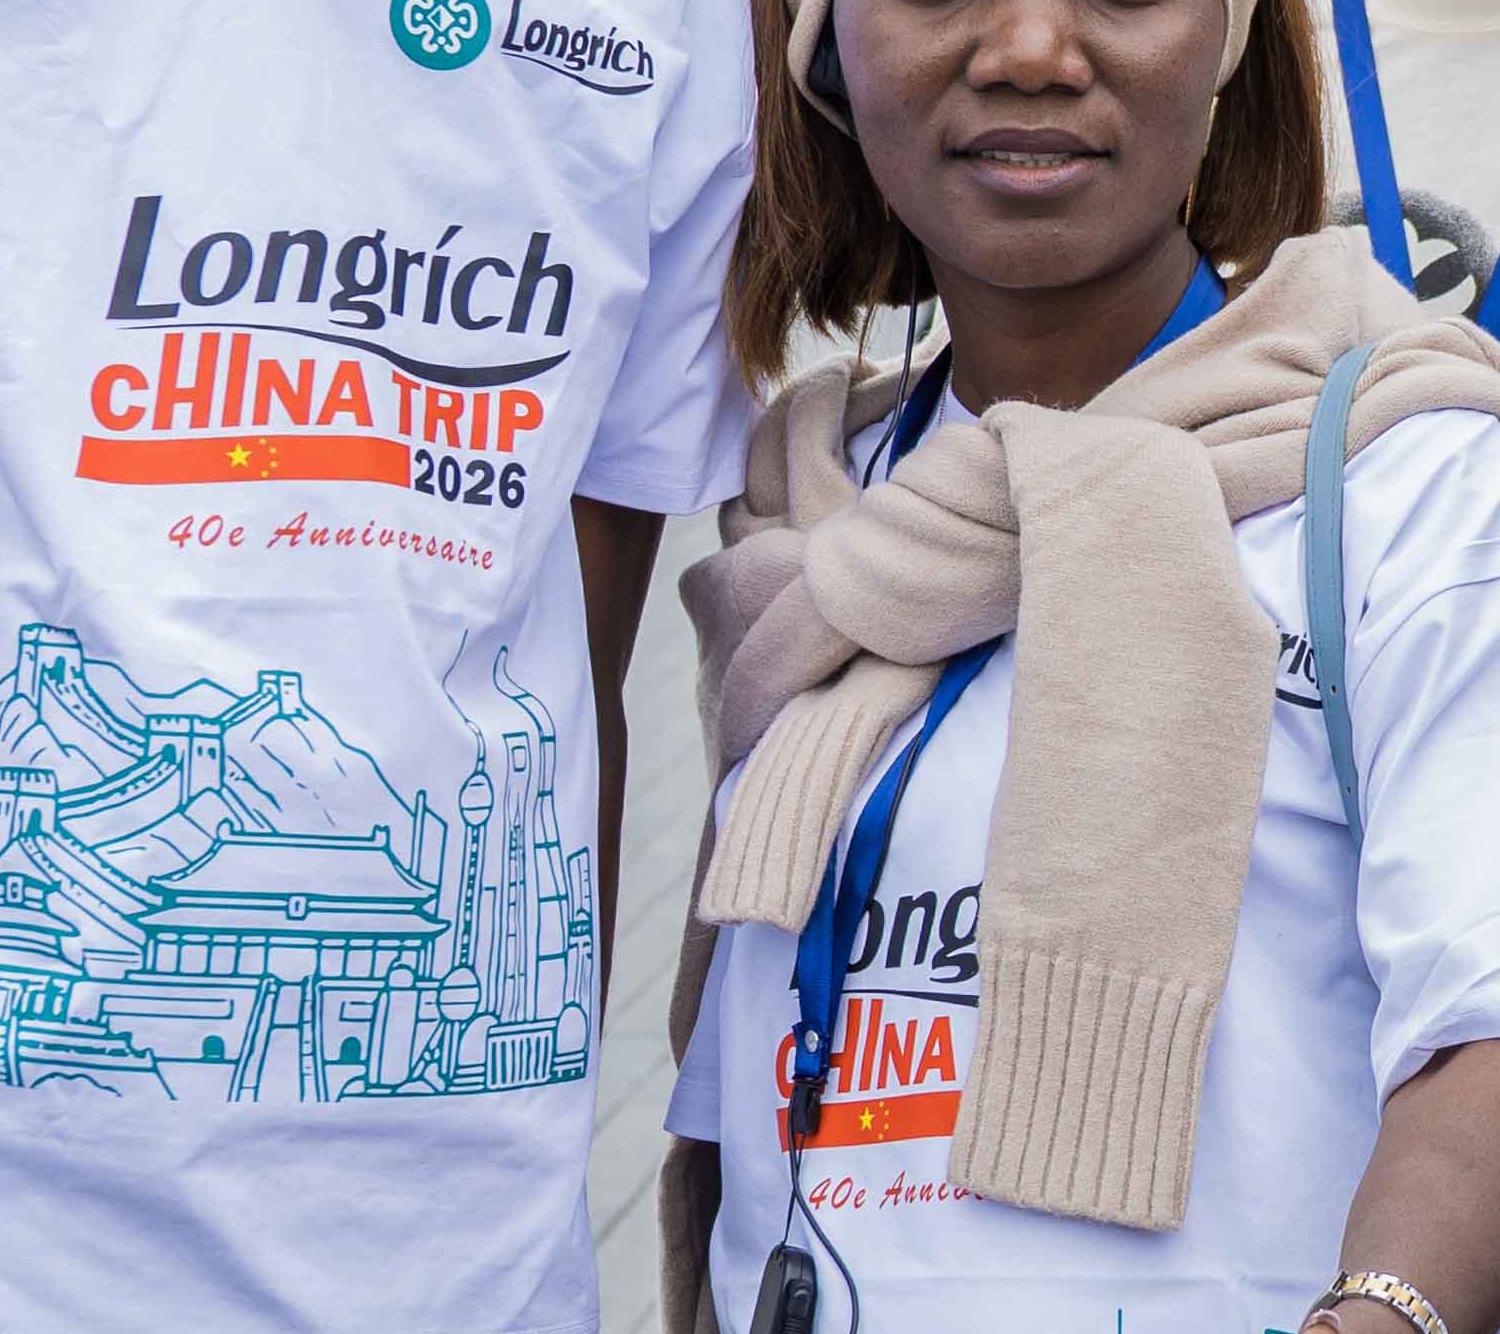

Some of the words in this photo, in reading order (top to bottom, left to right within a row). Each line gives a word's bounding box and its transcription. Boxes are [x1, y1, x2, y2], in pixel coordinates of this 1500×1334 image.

[89, 331, 373, 432] CHINA
[391, 369, 545, 454] TRIP
[413, 448, 527, 509] 2026
[168, 515, 244, 548] 40e
[267, 511, 493, 570] Anniversaire
[809, 1176, 867, 1211] 40e
